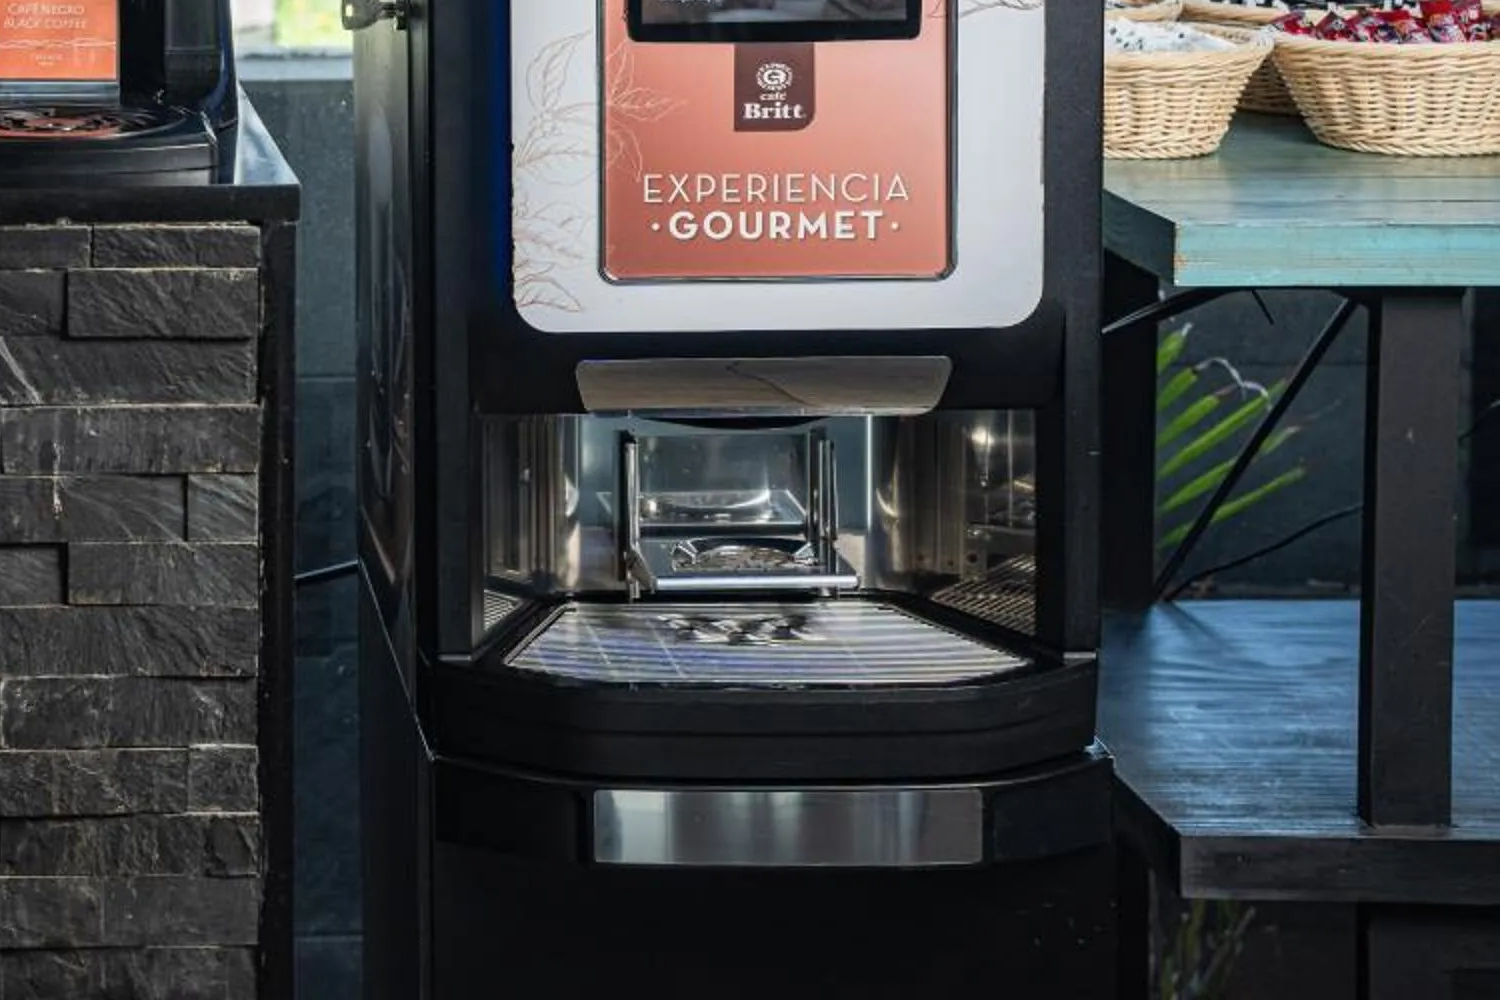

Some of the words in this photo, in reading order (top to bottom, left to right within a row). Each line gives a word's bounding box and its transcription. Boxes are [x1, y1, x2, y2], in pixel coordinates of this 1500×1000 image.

[742, 101, 806, 119] Britt
[643, 173, 910, 204] EXPERIENCIA
[668, 210, 884, 241] GOURMET
